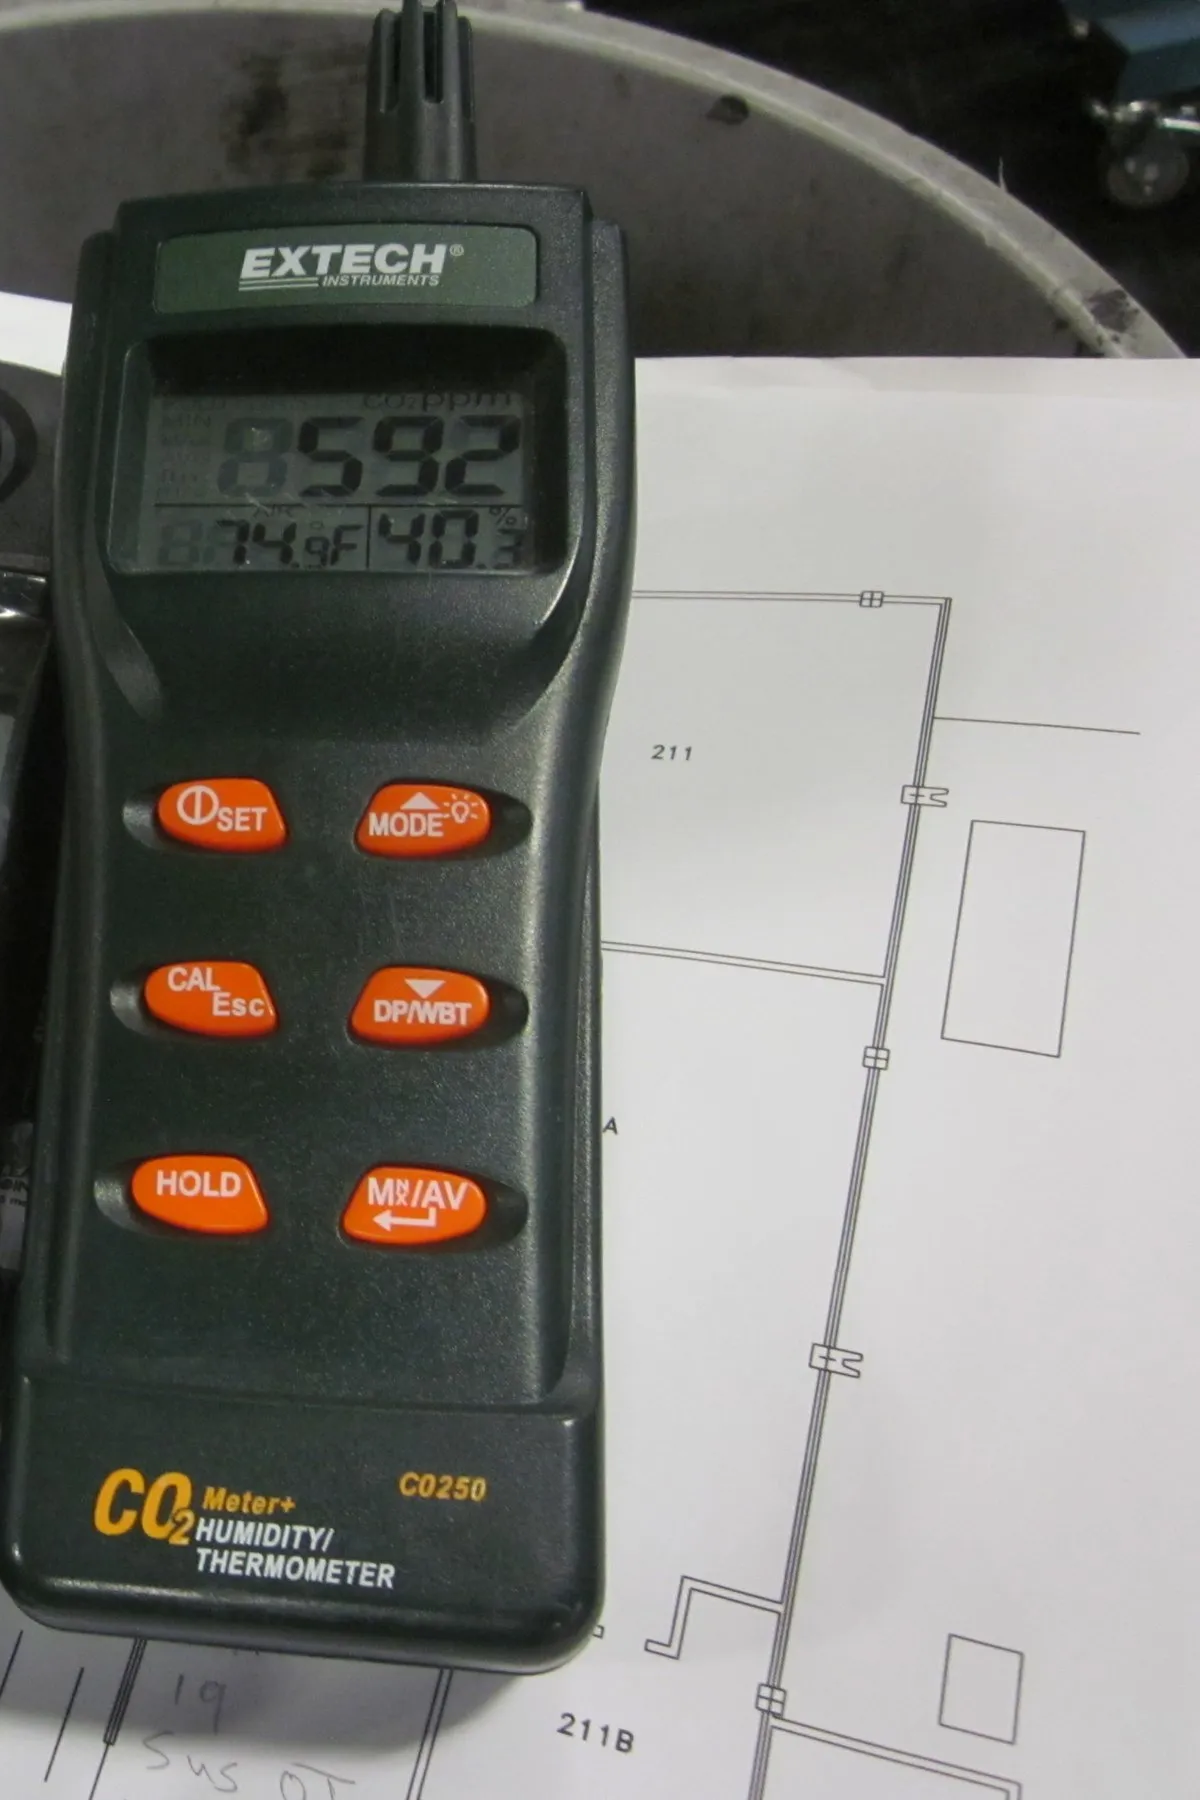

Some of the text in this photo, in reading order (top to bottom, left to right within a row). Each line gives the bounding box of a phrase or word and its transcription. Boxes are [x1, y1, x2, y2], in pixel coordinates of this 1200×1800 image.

[322, 274, 440, 287] INSTRUMENTS
[297, 414, 522, 496] 592
[650, 744, 694, 762] 211
[217, 807, 267, 832] SET
[369, 811, 444, 837] MODE
[167, 967, 220, 992] CAL
[373, 999, 472, 1026] DP/WBT
[156, 1170, 242, 1198] HOLD
[202, 1485, 296, 1516] Meter+
[195, 1516, 334, 1552] HUMIDITY/
[196, 1547, 395, 1590] THERMOMETER
[556, 1712, 635, 1754] 211B
